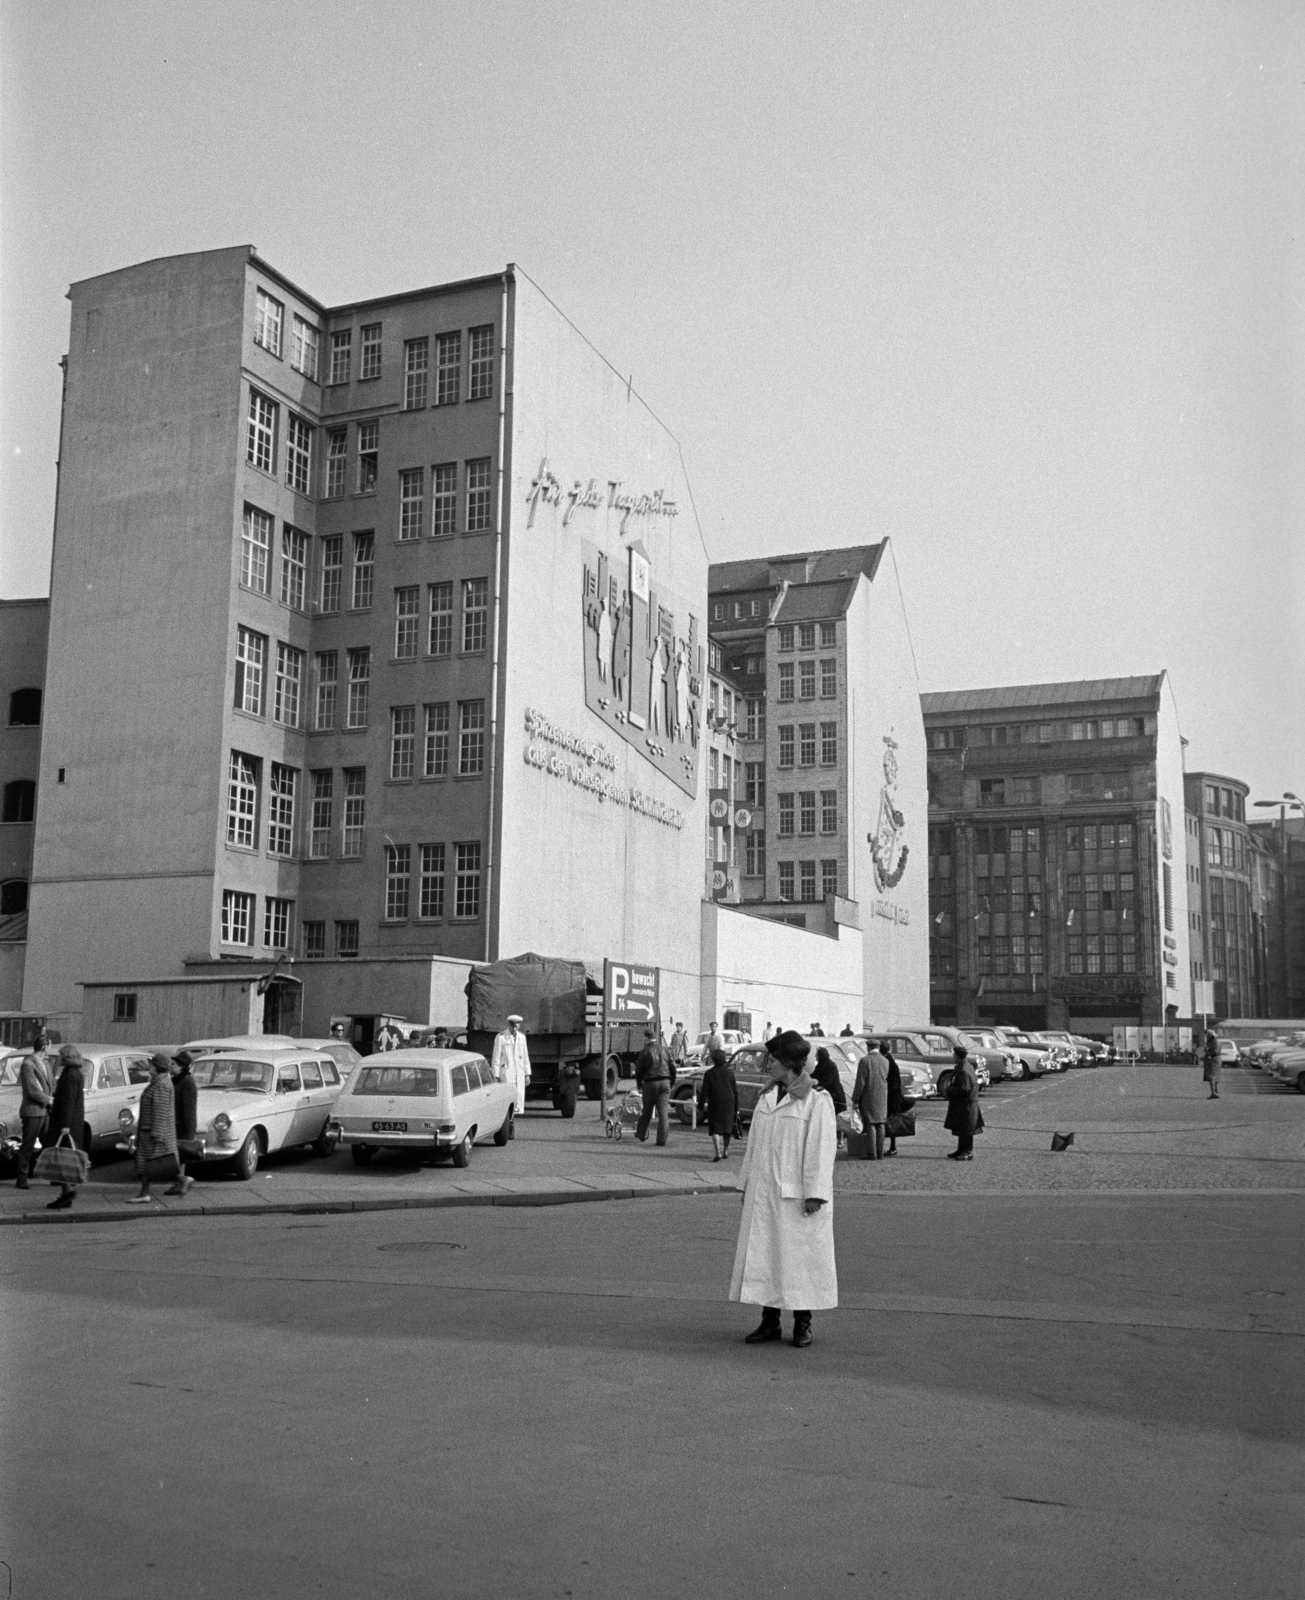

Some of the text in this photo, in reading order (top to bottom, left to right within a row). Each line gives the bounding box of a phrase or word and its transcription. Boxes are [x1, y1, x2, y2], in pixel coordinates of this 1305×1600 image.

[523, 746, 548, 771] aus
[547, 751, 569, 780] der
[611, 966, 629, 1010] P
